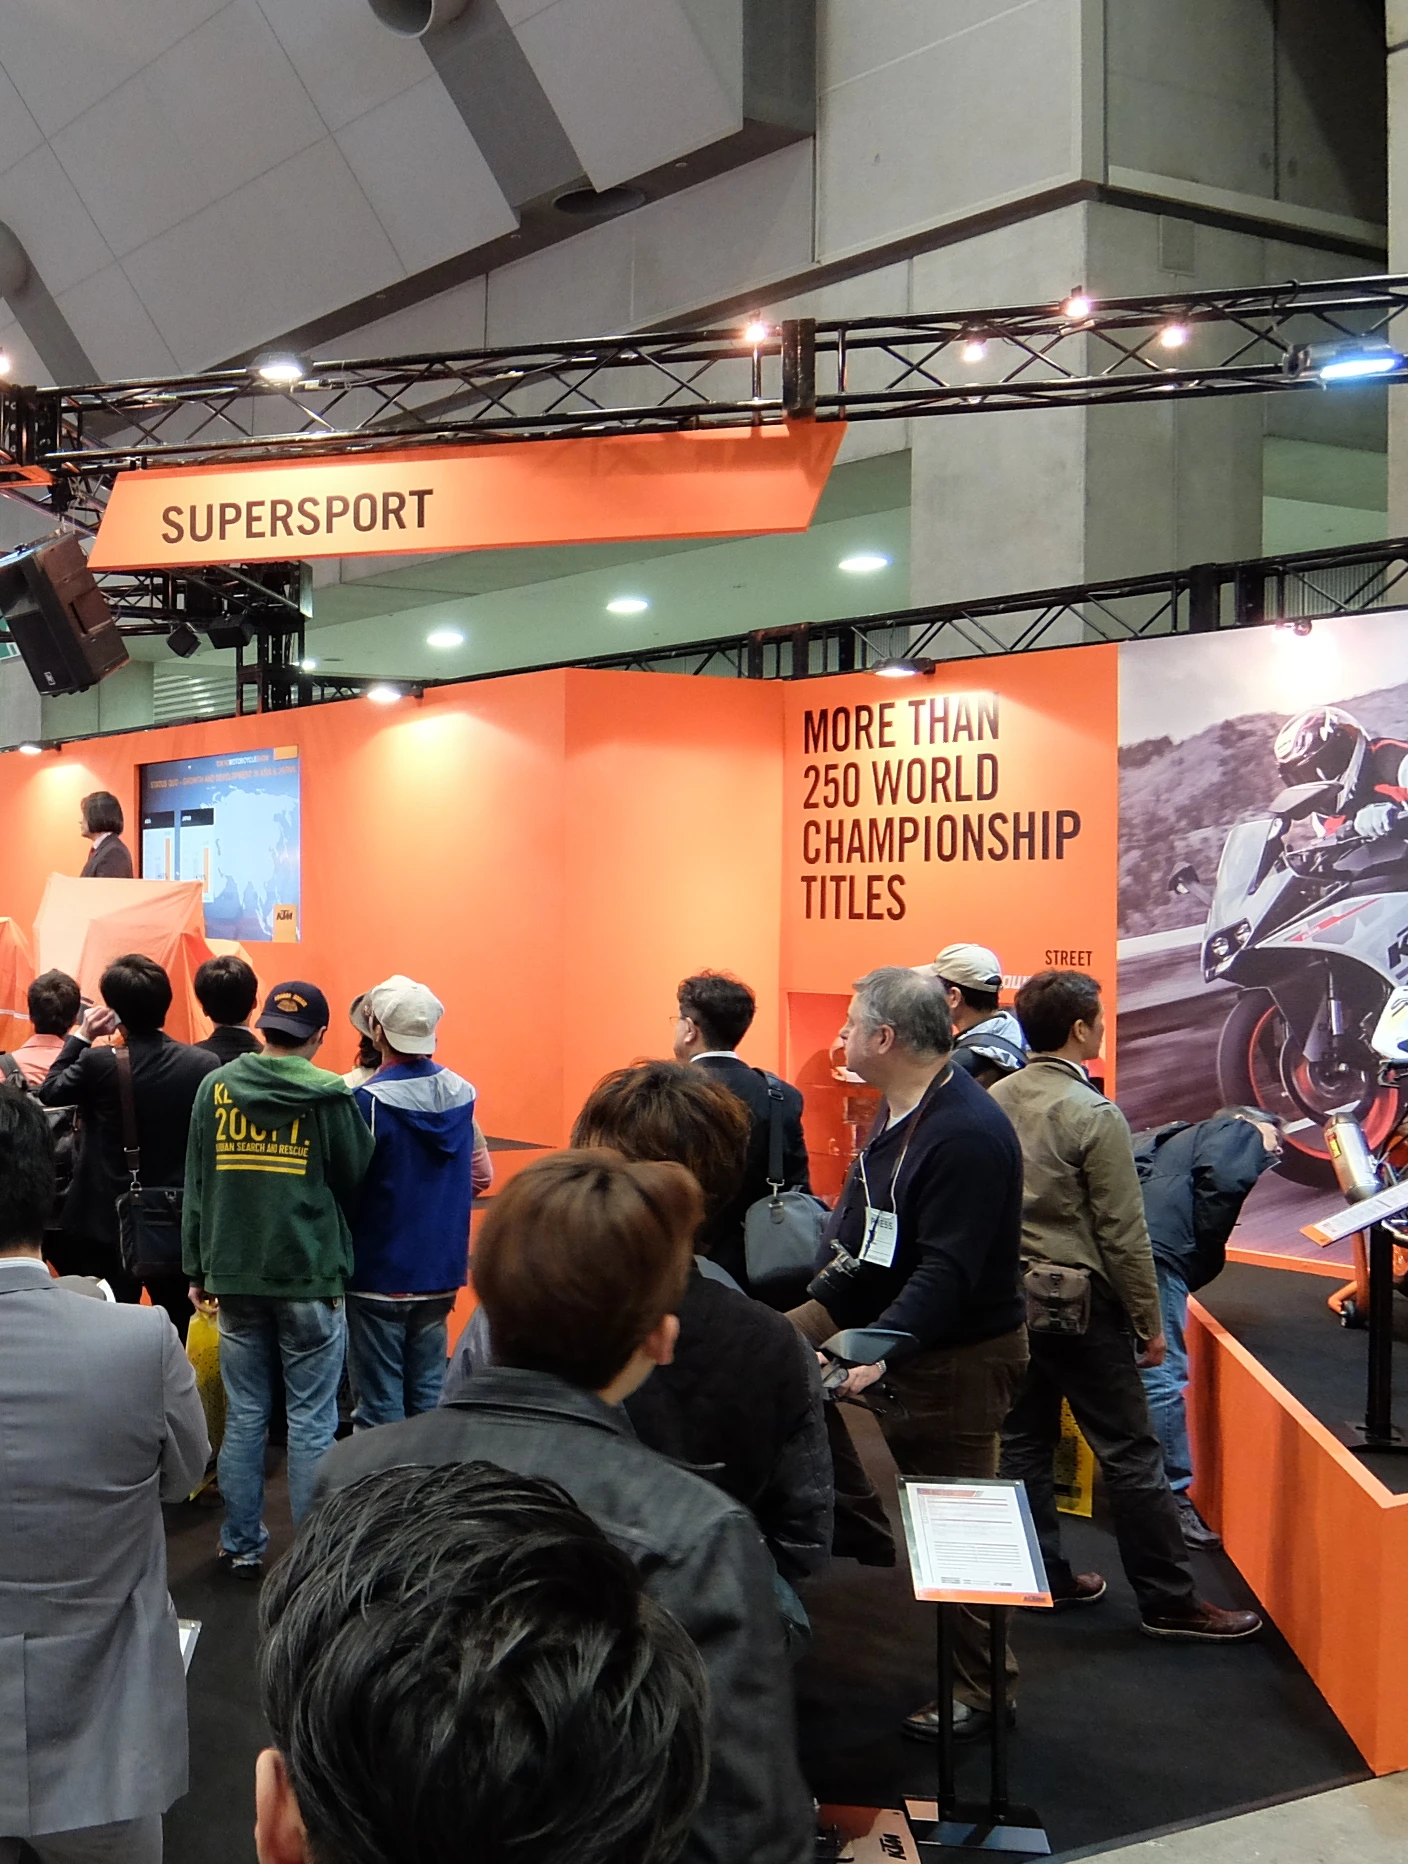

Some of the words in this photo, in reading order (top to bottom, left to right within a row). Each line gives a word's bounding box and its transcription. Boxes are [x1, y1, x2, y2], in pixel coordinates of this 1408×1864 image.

[161, 488, 434, 543] SUPERSPORT
[803, 702, 896, 754] MORE
[908, 692, 1000, 745] THAN
[803, 762, 861, 809] 250
[871, 753, 999, 806] WORLD
[803, 810, 1082, 865] CHAMPIONSHIP
[276, 909, 293, 921] KTM
[801, 874, 907, 921] TITLES
[1045, 950, 1093, 967] STREET
[236, 1142, 266, 1153] SEARCH
[279, 1144, 310, 1158] RESCUE
[871, 1216, 893, 1230] PESS
